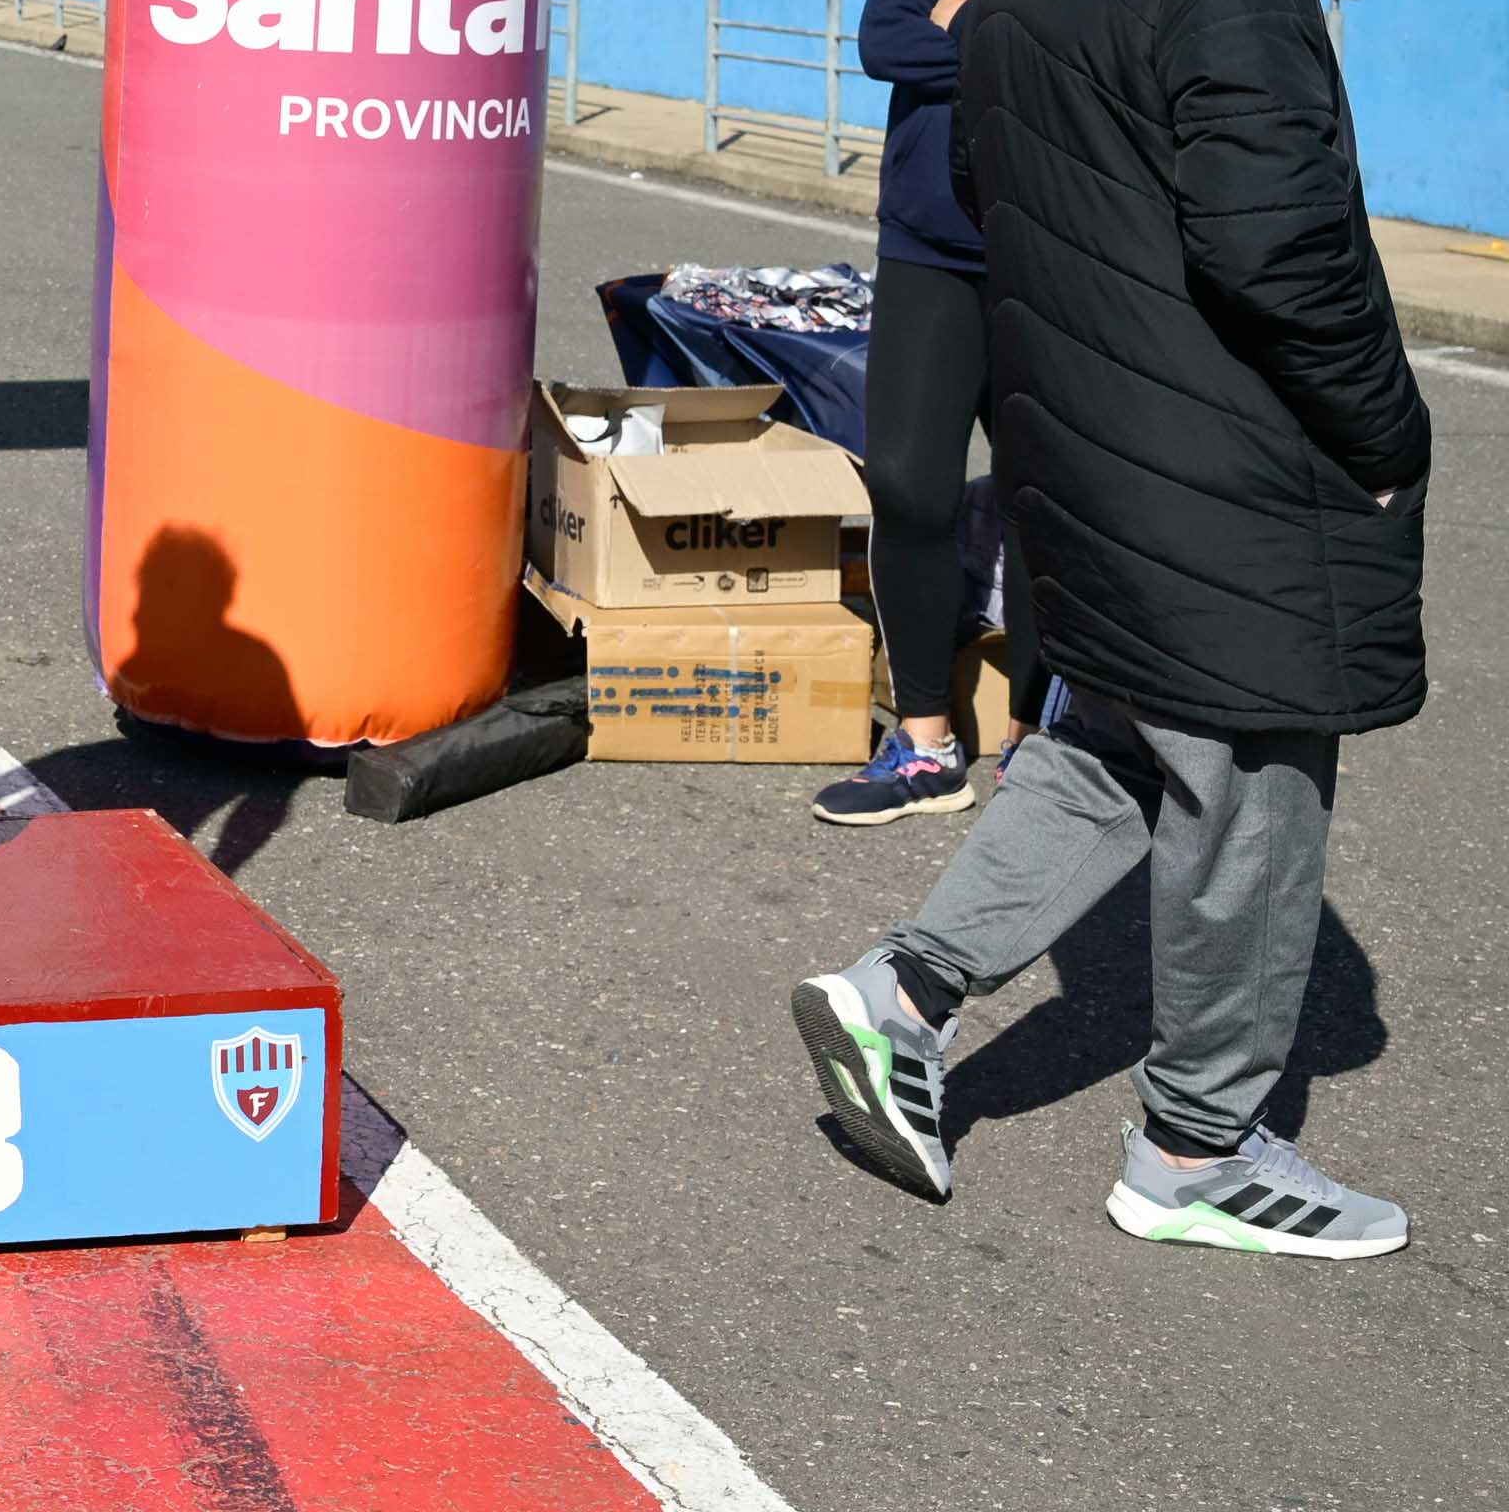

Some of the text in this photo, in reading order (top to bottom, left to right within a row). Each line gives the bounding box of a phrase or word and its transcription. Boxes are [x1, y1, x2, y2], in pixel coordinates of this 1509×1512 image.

[279, 95, 531, 140] PROVINCIA
[540, 493, 586, 543] cliker
[665, 514, 787, 551] cliker
[247, 1090, 271, 1120] F
